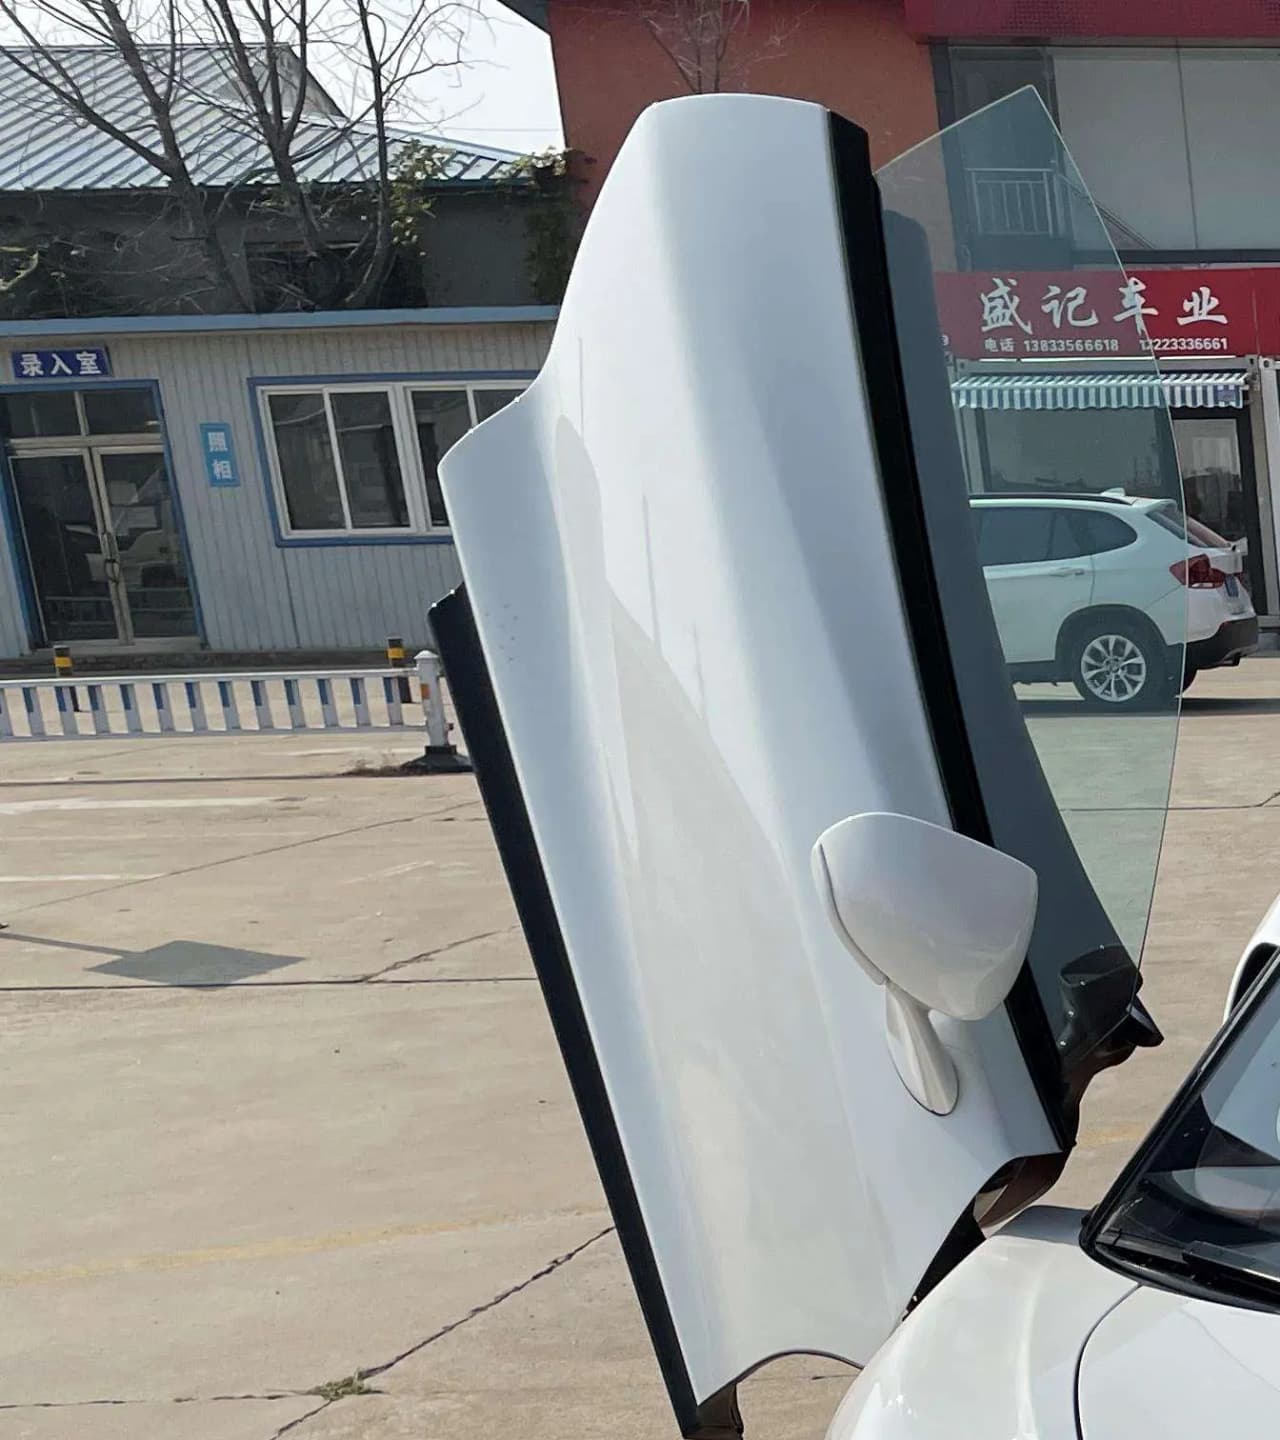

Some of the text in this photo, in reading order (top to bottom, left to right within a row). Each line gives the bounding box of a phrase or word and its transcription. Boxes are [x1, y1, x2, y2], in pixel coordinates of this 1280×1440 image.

[980, 277, 1228, 335] 盛记车业
[984, 337, 1014, 353] 电话
[20, 351, 101, 377] 录入室
